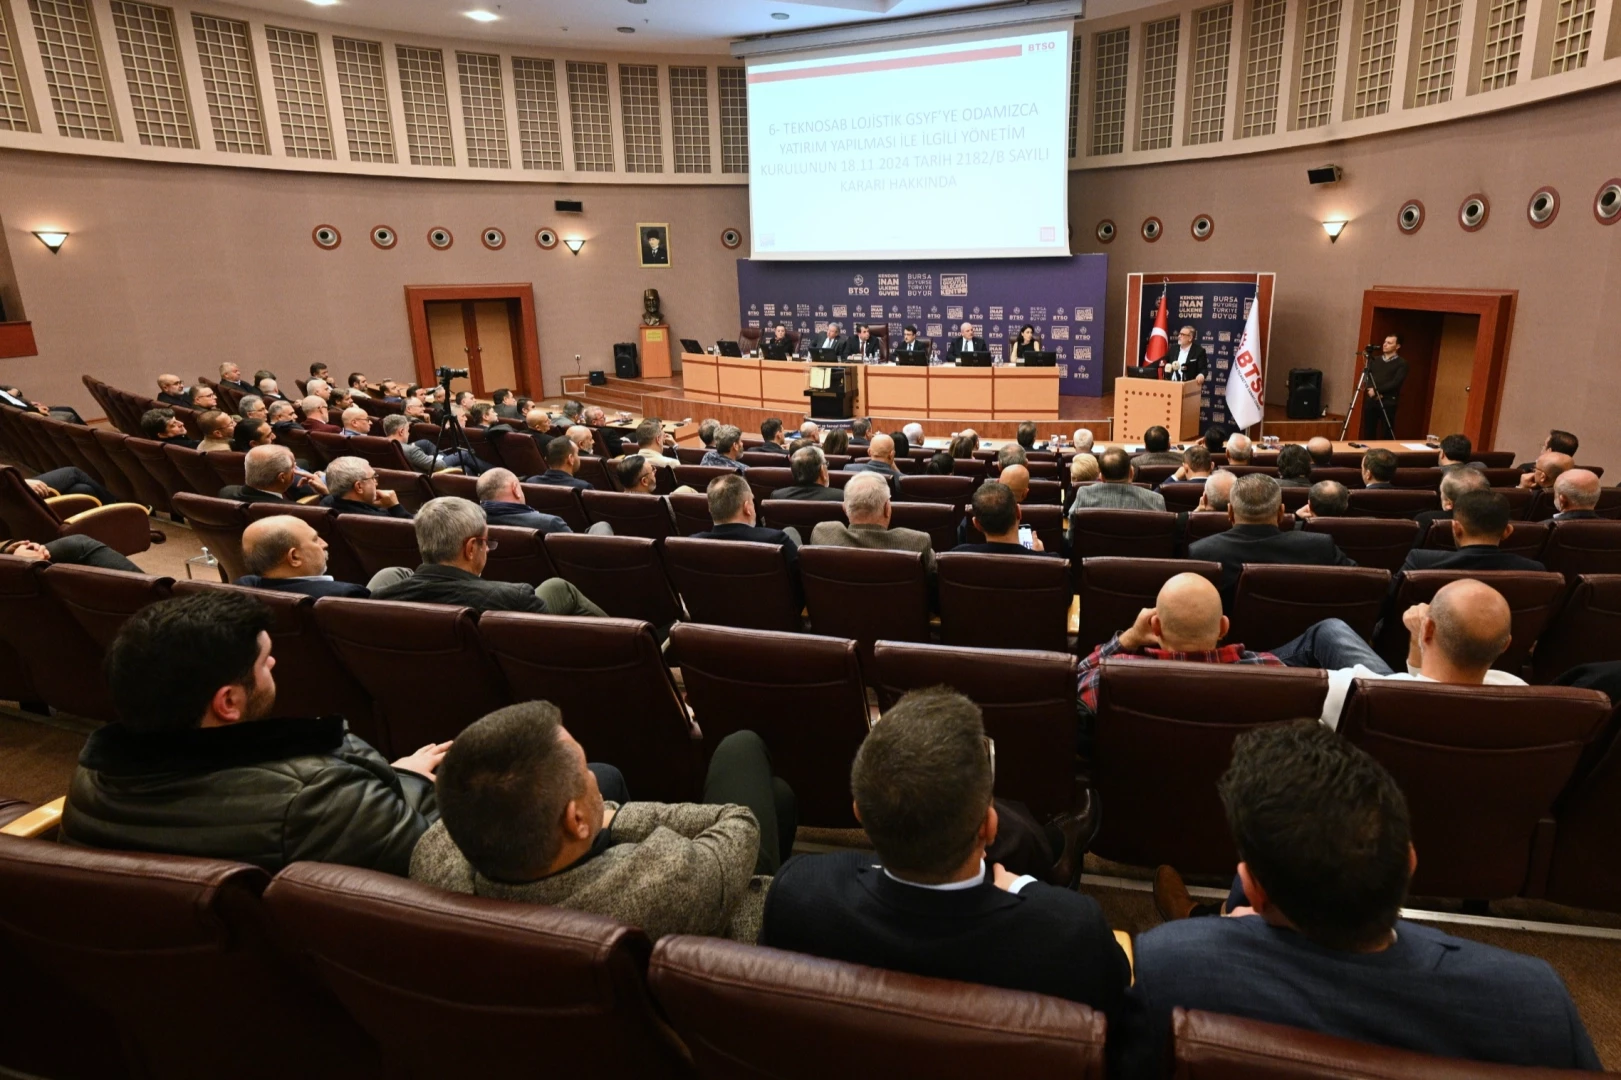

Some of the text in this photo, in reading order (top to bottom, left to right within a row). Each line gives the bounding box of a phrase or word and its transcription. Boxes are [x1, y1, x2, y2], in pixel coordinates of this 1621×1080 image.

[1028, 42, 1056, 51] BTSO
[768, 124, 780, 136] 6-
[784, 118, 848, 134] TEKNOSAB
[851, 110, 902, 131] LOJİSTİK
[962, 102, 1039, 122] ODAMIZCA
[780, 124, 1025, 155] YATIRIM YAPILMASI İLE İLGİLİ YÖNETİM
[760, 147, 1049, 176] KURULUNUN 18.11.2024 TARİH 2182/B SAYILI
[840, 175, 958, 192] KARARI HAKKINDA
